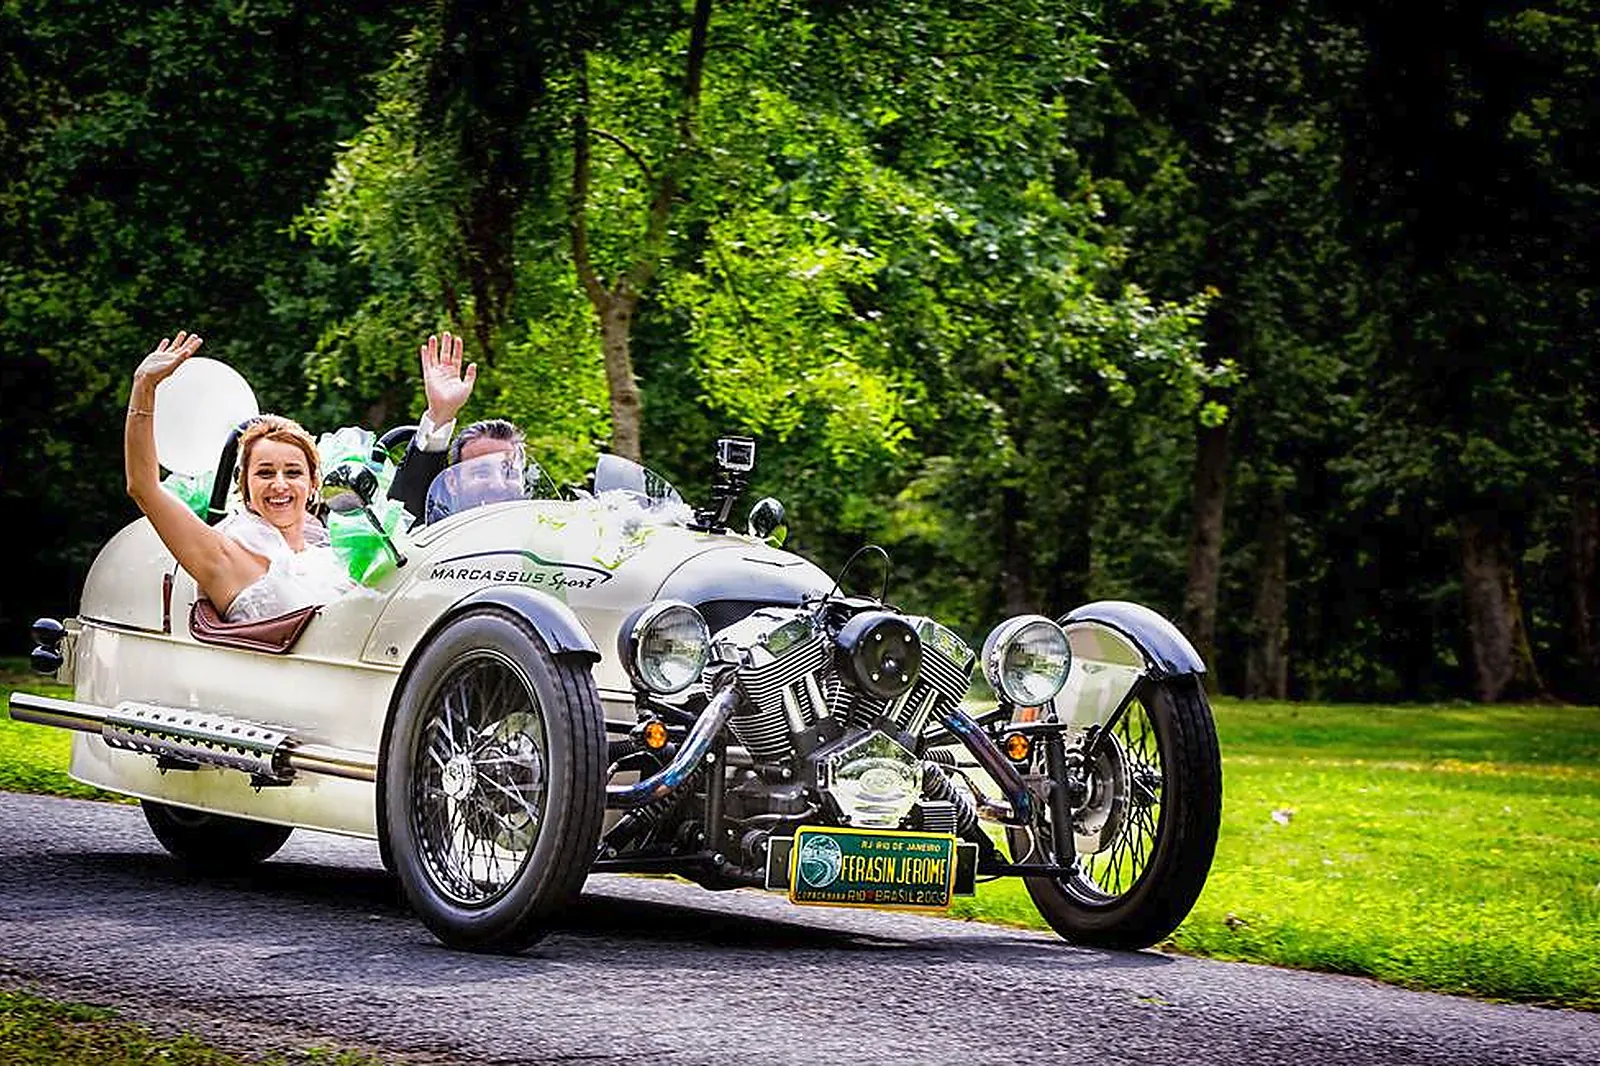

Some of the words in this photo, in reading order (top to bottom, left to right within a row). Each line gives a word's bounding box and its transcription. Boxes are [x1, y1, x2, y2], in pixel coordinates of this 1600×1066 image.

[430, 567, 546, 584] MARCASSUS
[547, 572, 597, 591] Sport
[875, 841, 890, 850] RIO
[892, 842, 904, 851] DE
[906, 842, 940, 852] JANEIRO
[841, 855, 895, 883] FERASIN
[897, 857, 946, 886] JEROME
[847, 889, 866, 901] RIO
[875, 890, 914, 903] BRASIL
[916, 890, 947, 905] 2003
